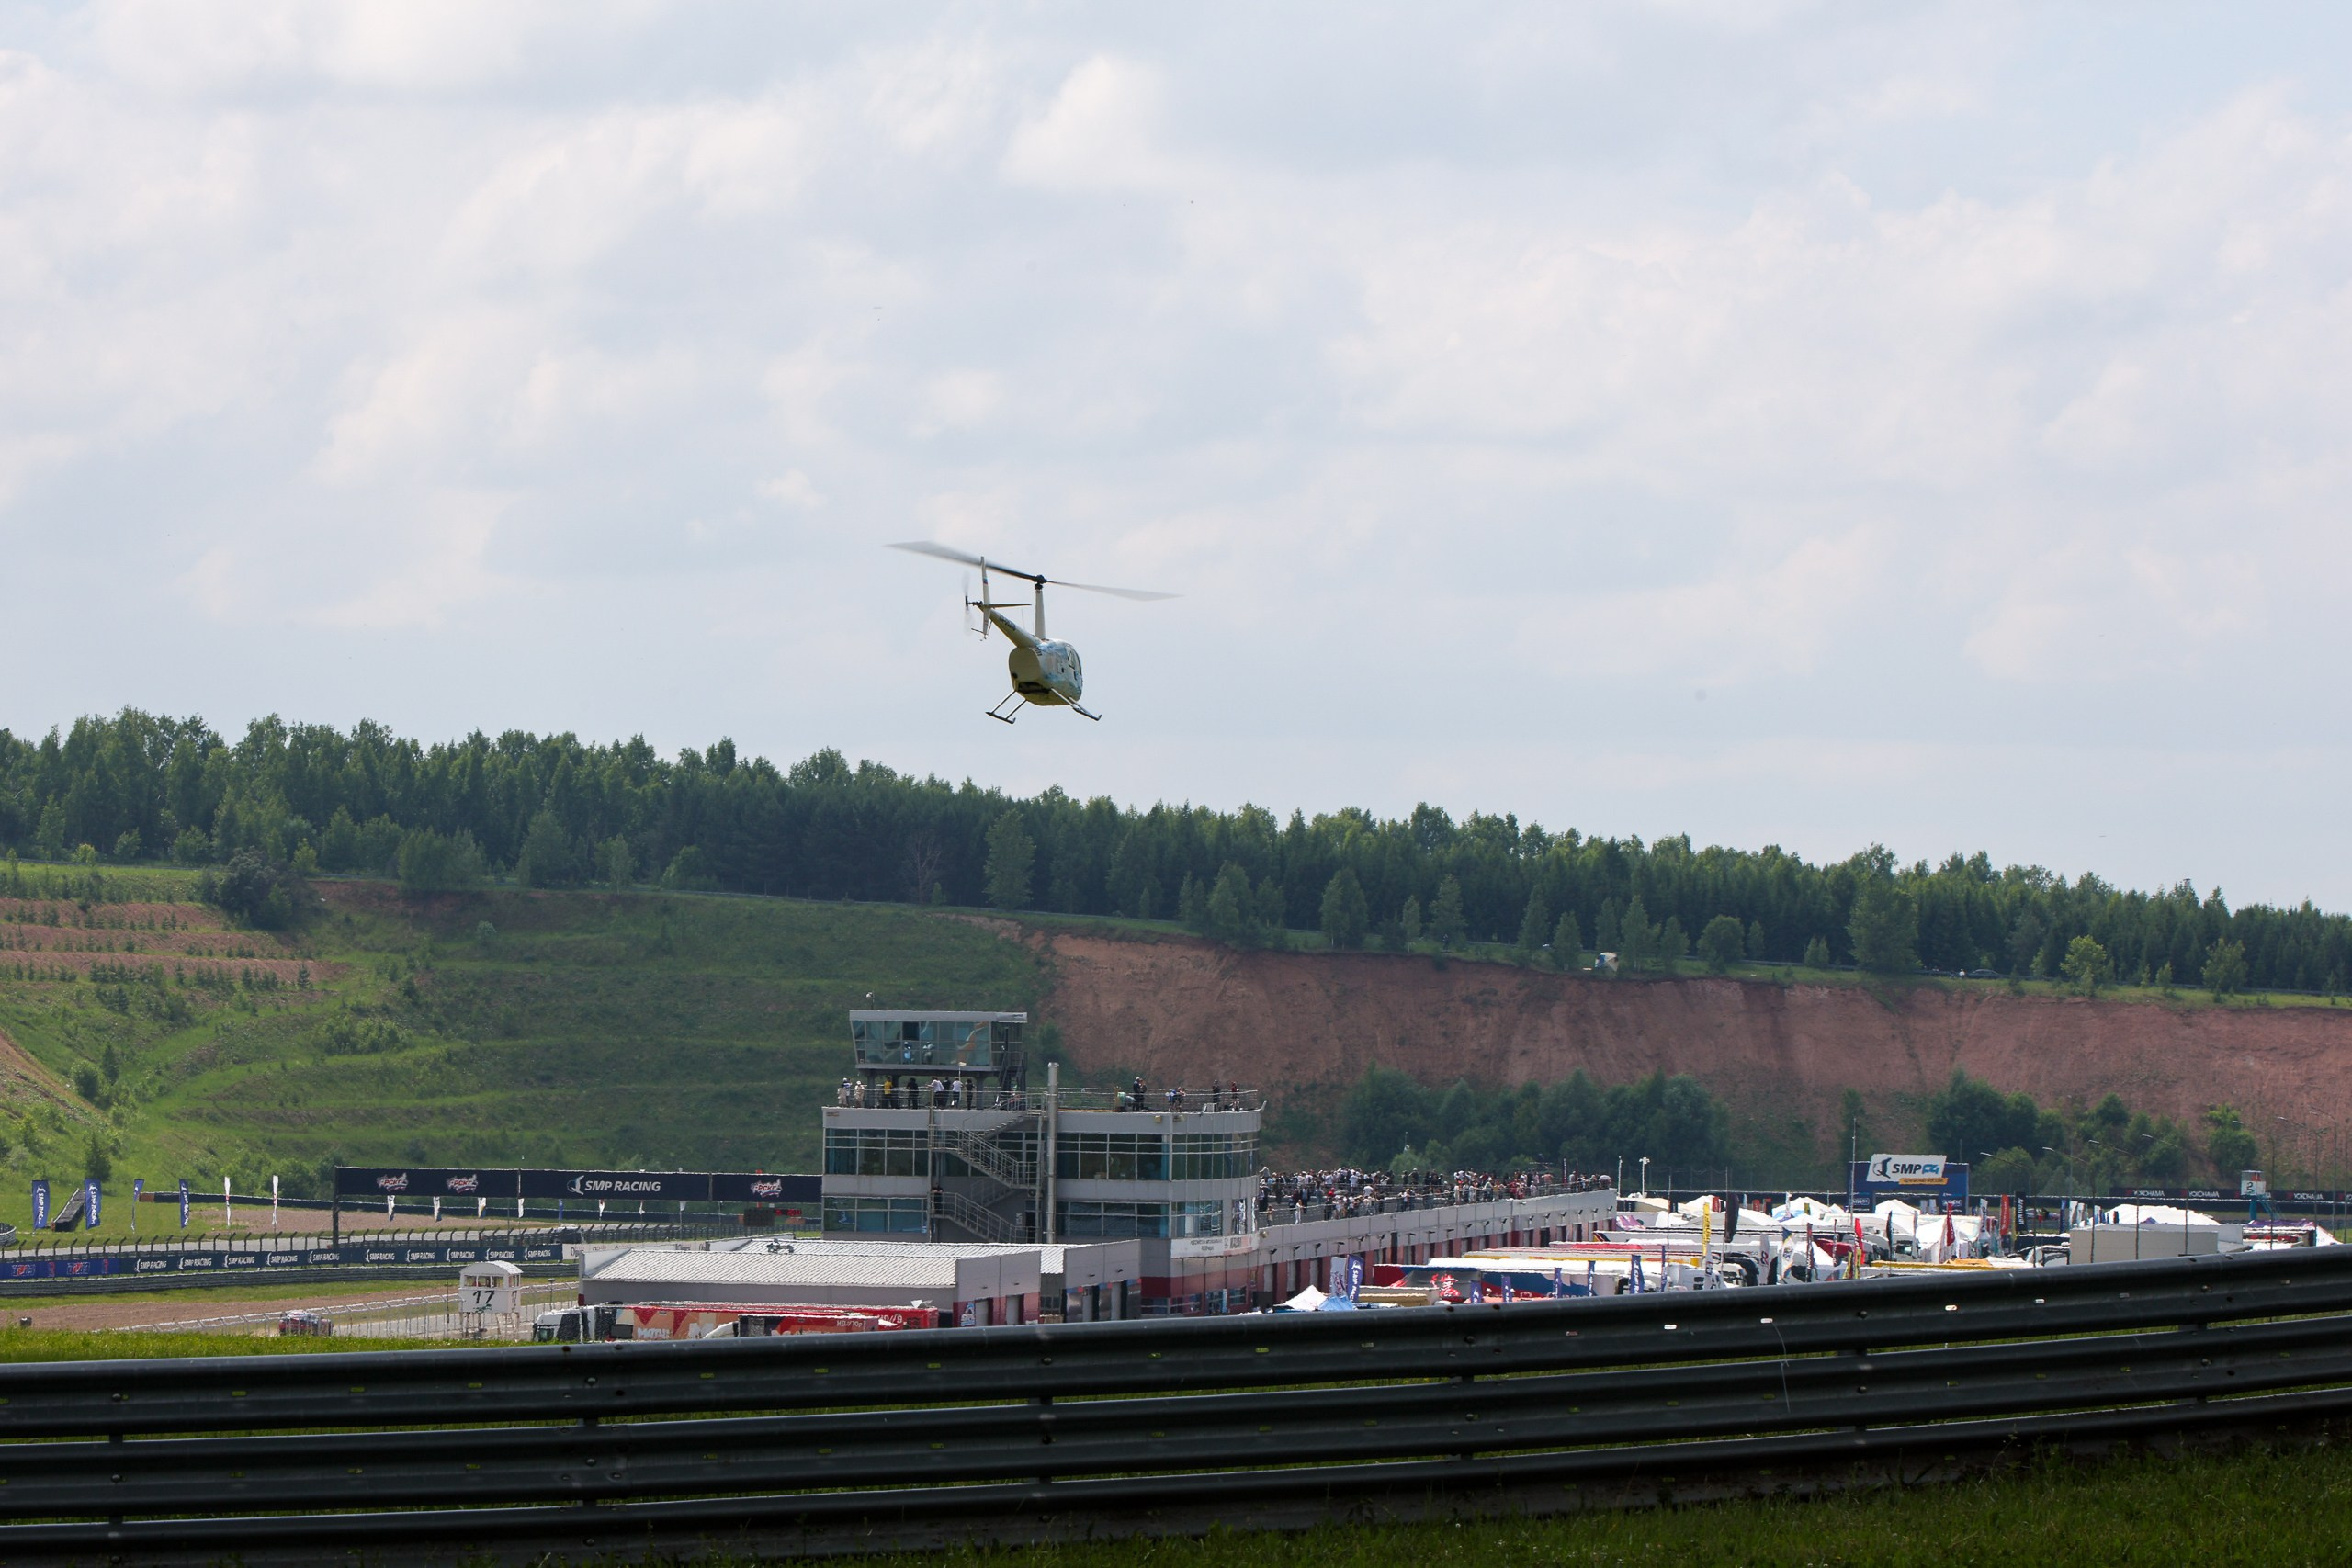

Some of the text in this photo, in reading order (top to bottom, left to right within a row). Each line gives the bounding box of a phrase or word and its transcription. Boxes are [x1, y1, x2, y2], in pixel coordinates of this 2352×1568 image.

[1892, 1163, 1922, 1174] SMP
[584, 1180, 661, 1192] SMP RACING
[472, 1290, 494, 1304] 17
